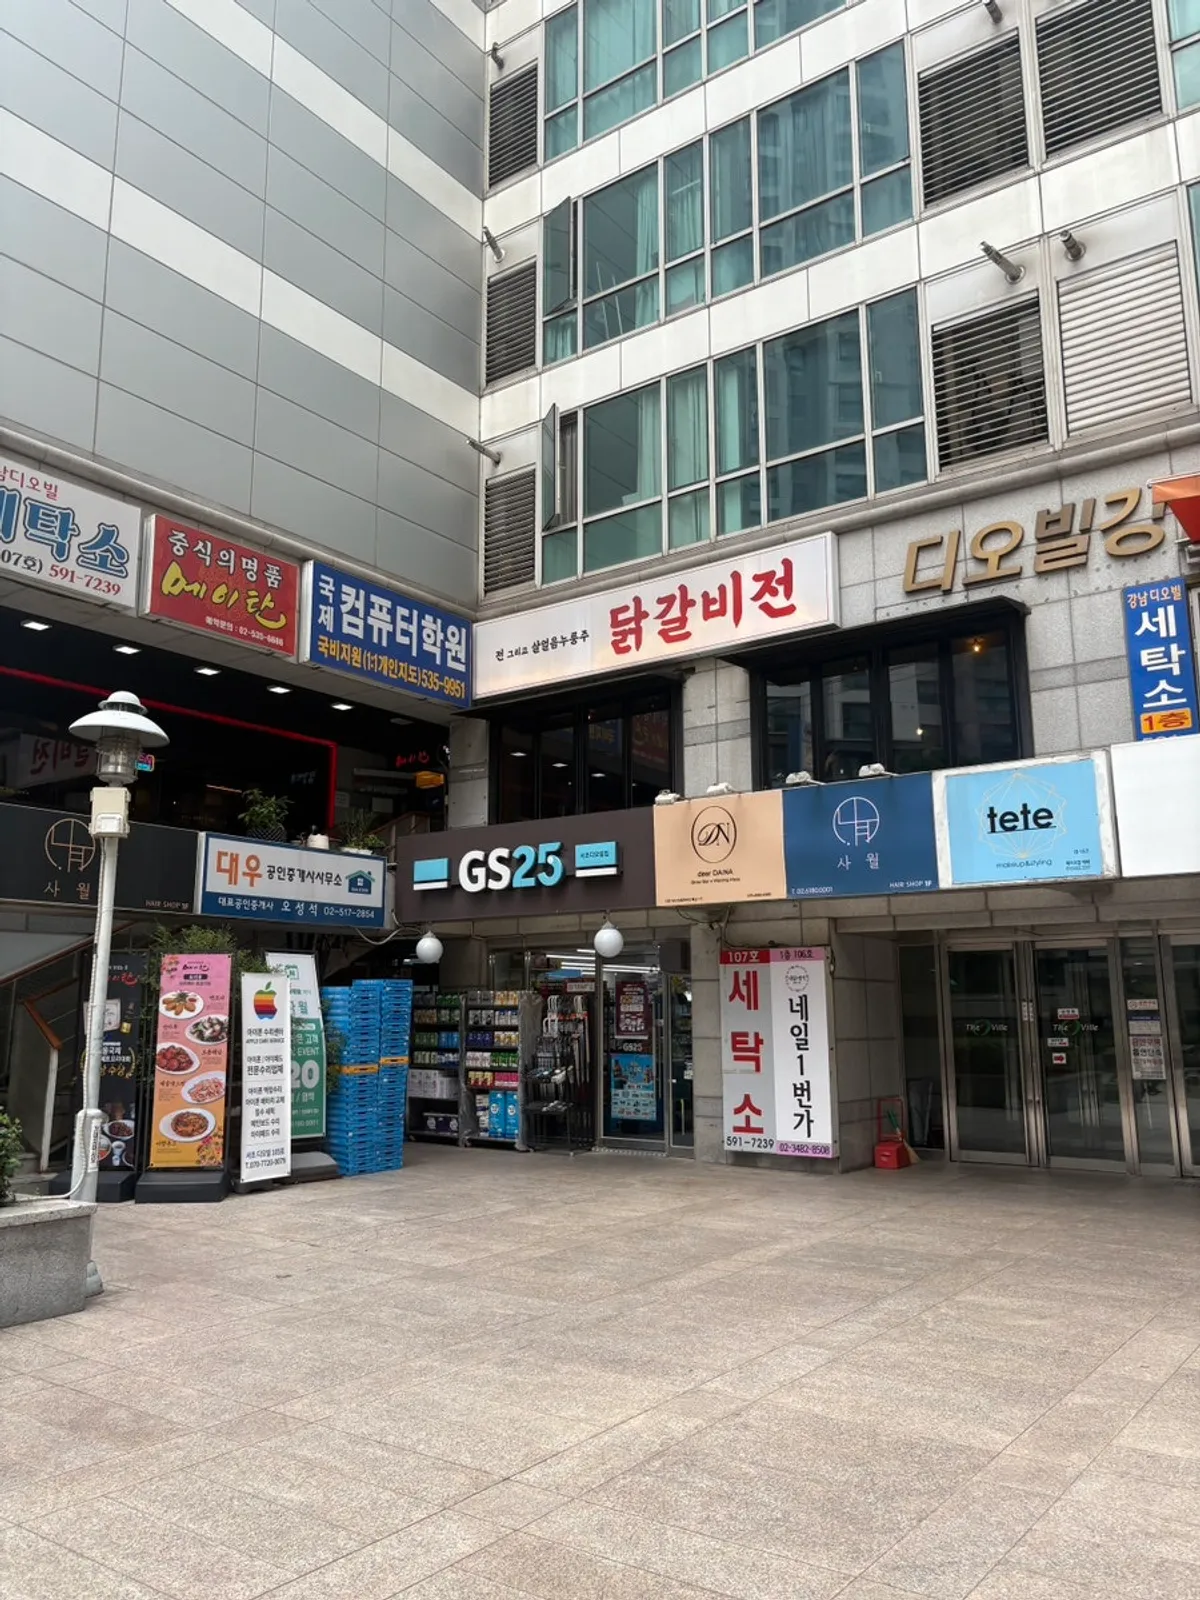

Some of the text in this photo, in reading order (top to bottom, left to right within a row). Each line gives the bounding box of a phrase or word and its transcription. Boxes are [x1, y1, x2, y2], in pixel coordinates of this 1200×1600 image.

[49, 564, 121, 596] 591-7239
[161, 561, 287, 629] 메이탄
[318, 574, 335, 633] 국제
[609, 558, 797, 654] 닭갈비전
[340, 583, 466, 672] 컴퓨터학원
[495, 648, 504, 662] 전
[507, 647, 528, 658] 그리고
[1135, 605, 1187, 708] 세탁소
[1143, 712, 1189, 731] 1층
[987, 803, 1054, 833] tete
[216, 851, 342, 887] 대우 공인중개사사무소
[458, 842, 565, 893] GS25
[323, 906, 375, 919] 02-517-2854
[728, 951, 760, 963] 107호
[729, 970, 764, 1135] 세탁소
[788, 994, 814, 1138] 네일1번가
[726, 1136, 775, 1149] 591-7239
